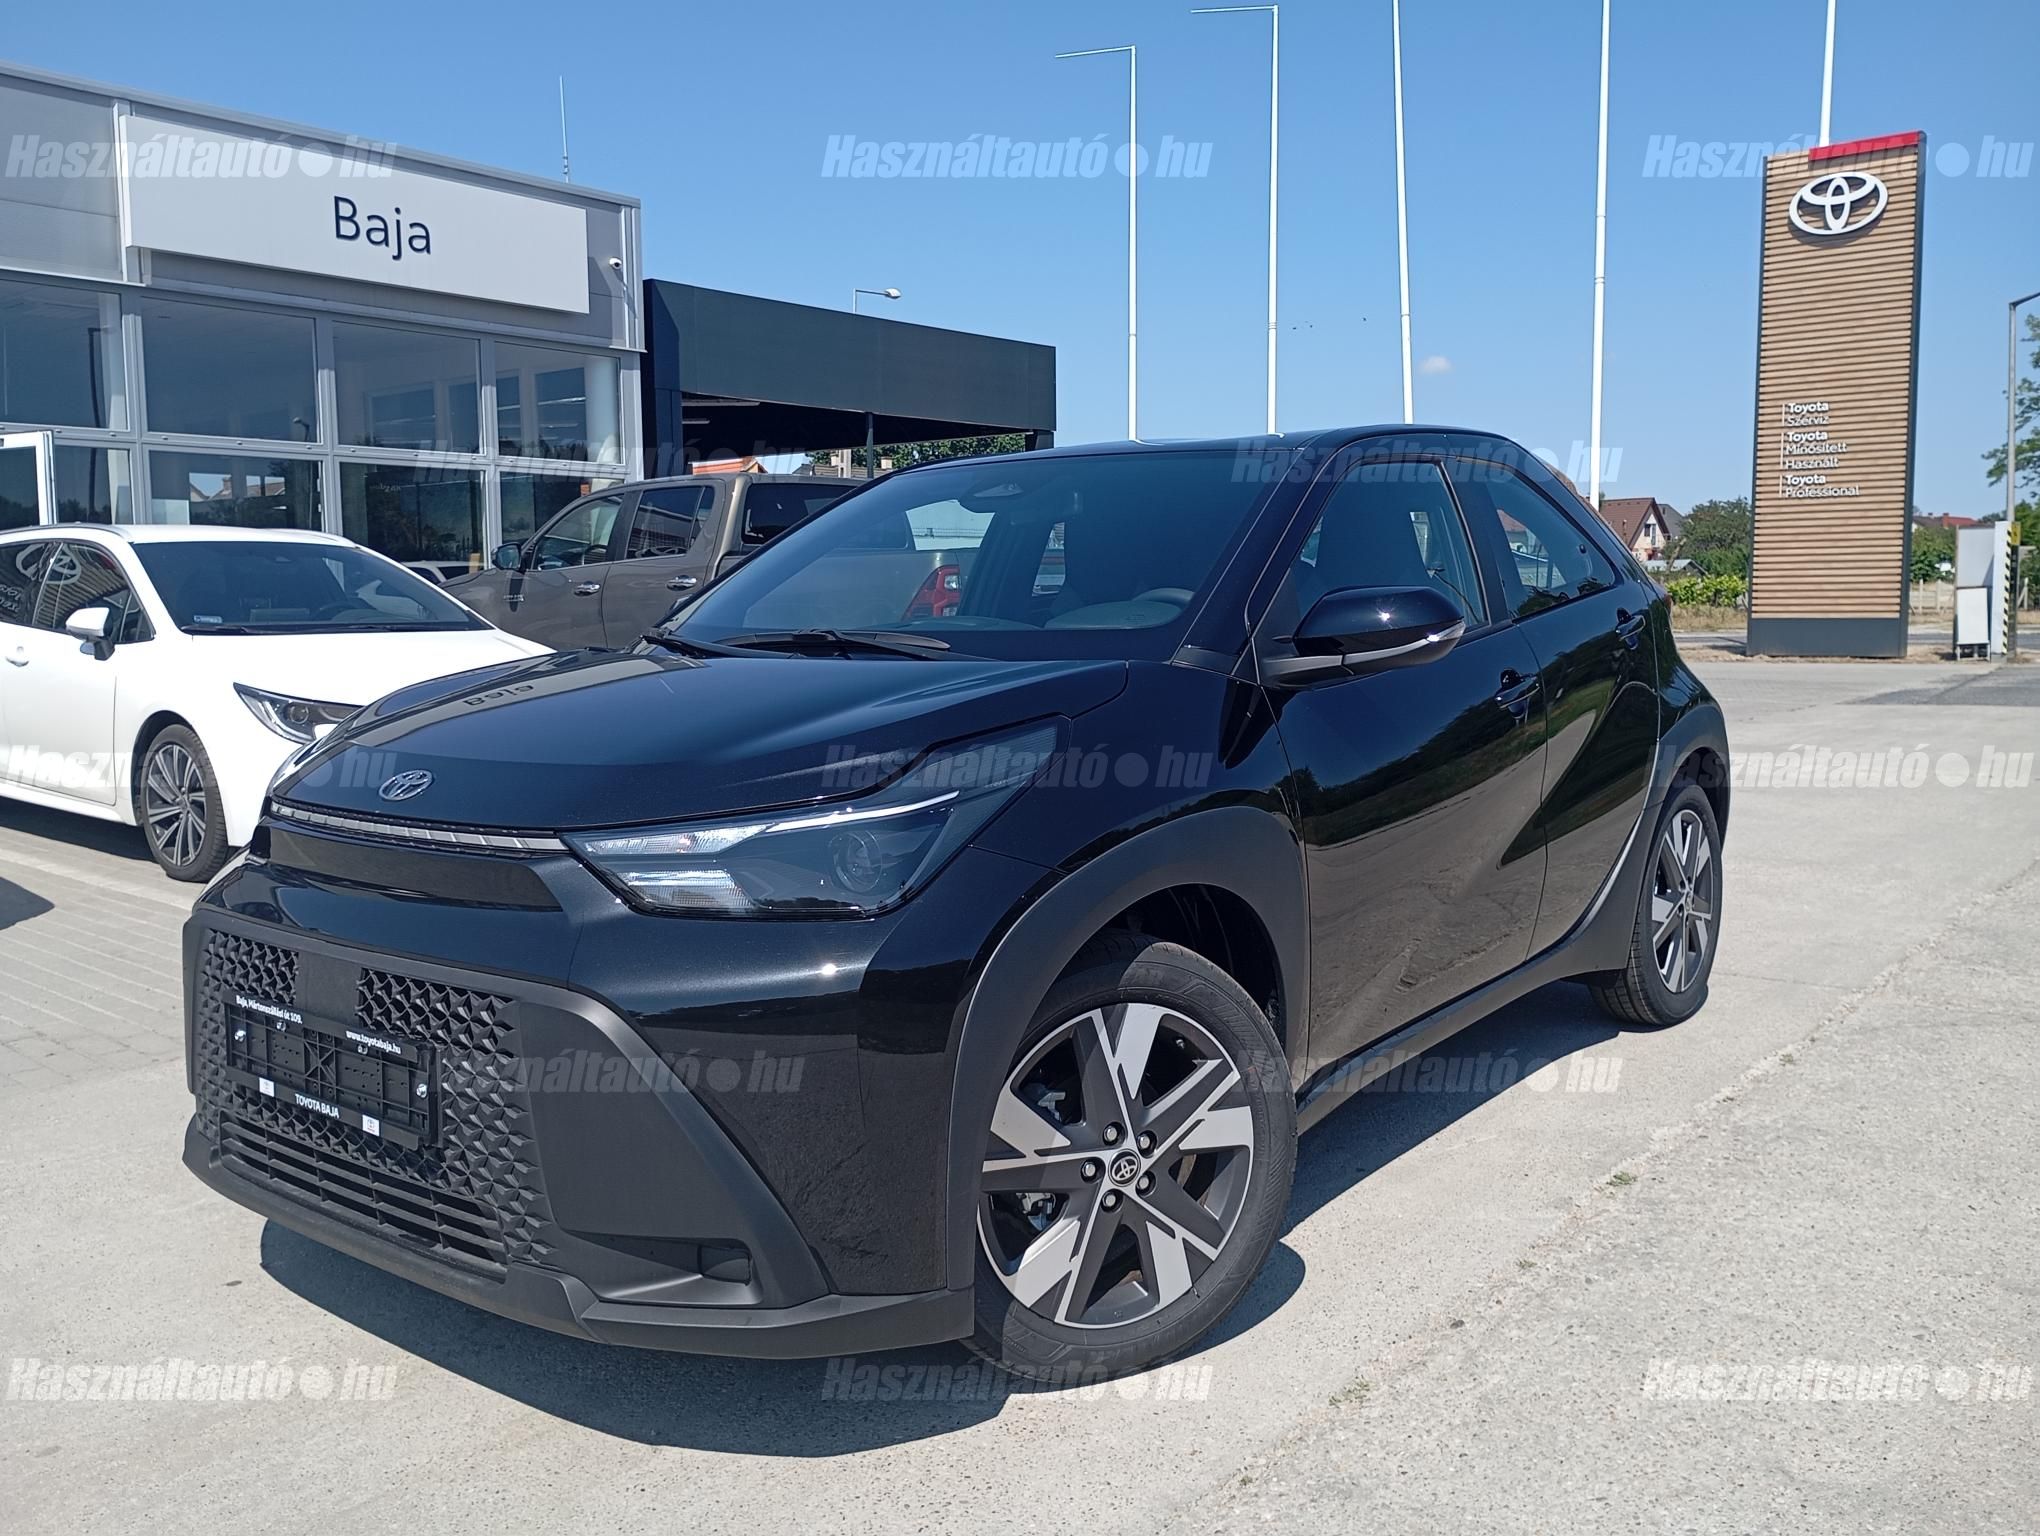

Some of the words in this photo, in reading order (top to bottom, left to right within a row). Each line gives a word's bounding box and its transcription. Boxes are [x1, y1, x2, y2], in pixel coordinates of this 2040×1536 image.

[334, 195, 431, 261] Baja
[1788, 401, 1829, 414] Toyota
[1787, 415, 1830, 426] Szerviz
[1787, 430, 1828, 443] Toyota
[1785, 474, 1826, 486] Toyota
[1785, 485, 1860, 497] Professional
[346, 1031, 401, 1054] www.toyotabaja.hu
[295, 1093, 320, 1112] TOYOTA
[321, 1103, 339, 1118] BAJA
